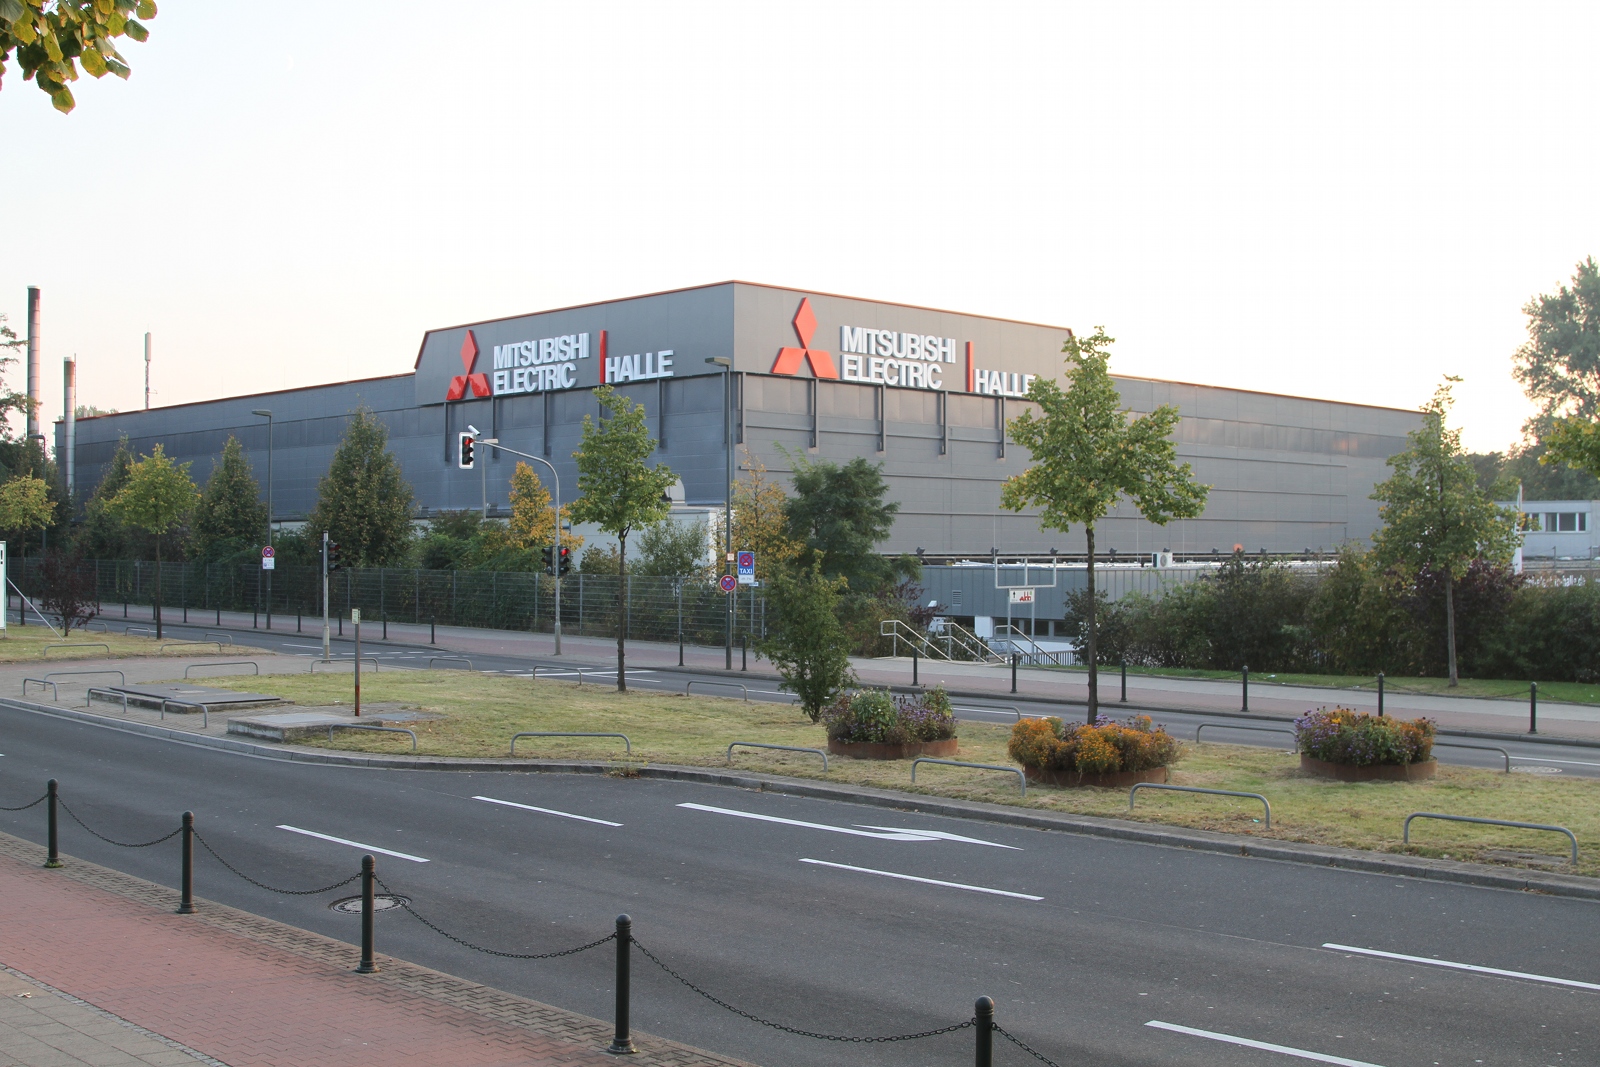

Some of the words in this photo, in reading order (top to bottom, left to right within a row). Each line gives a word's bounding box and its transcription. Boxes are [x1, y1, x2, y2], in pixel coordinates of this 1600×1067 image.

[494, 332, 590, 369] MITSUBISHI
[840, 325, 956, 363] MITSUBISHI
[493, 362, 577, 396] ELECTRIC
[604, 349, 674, 383] HALLE
[840, 354, 943, 389] ELECTRIC
